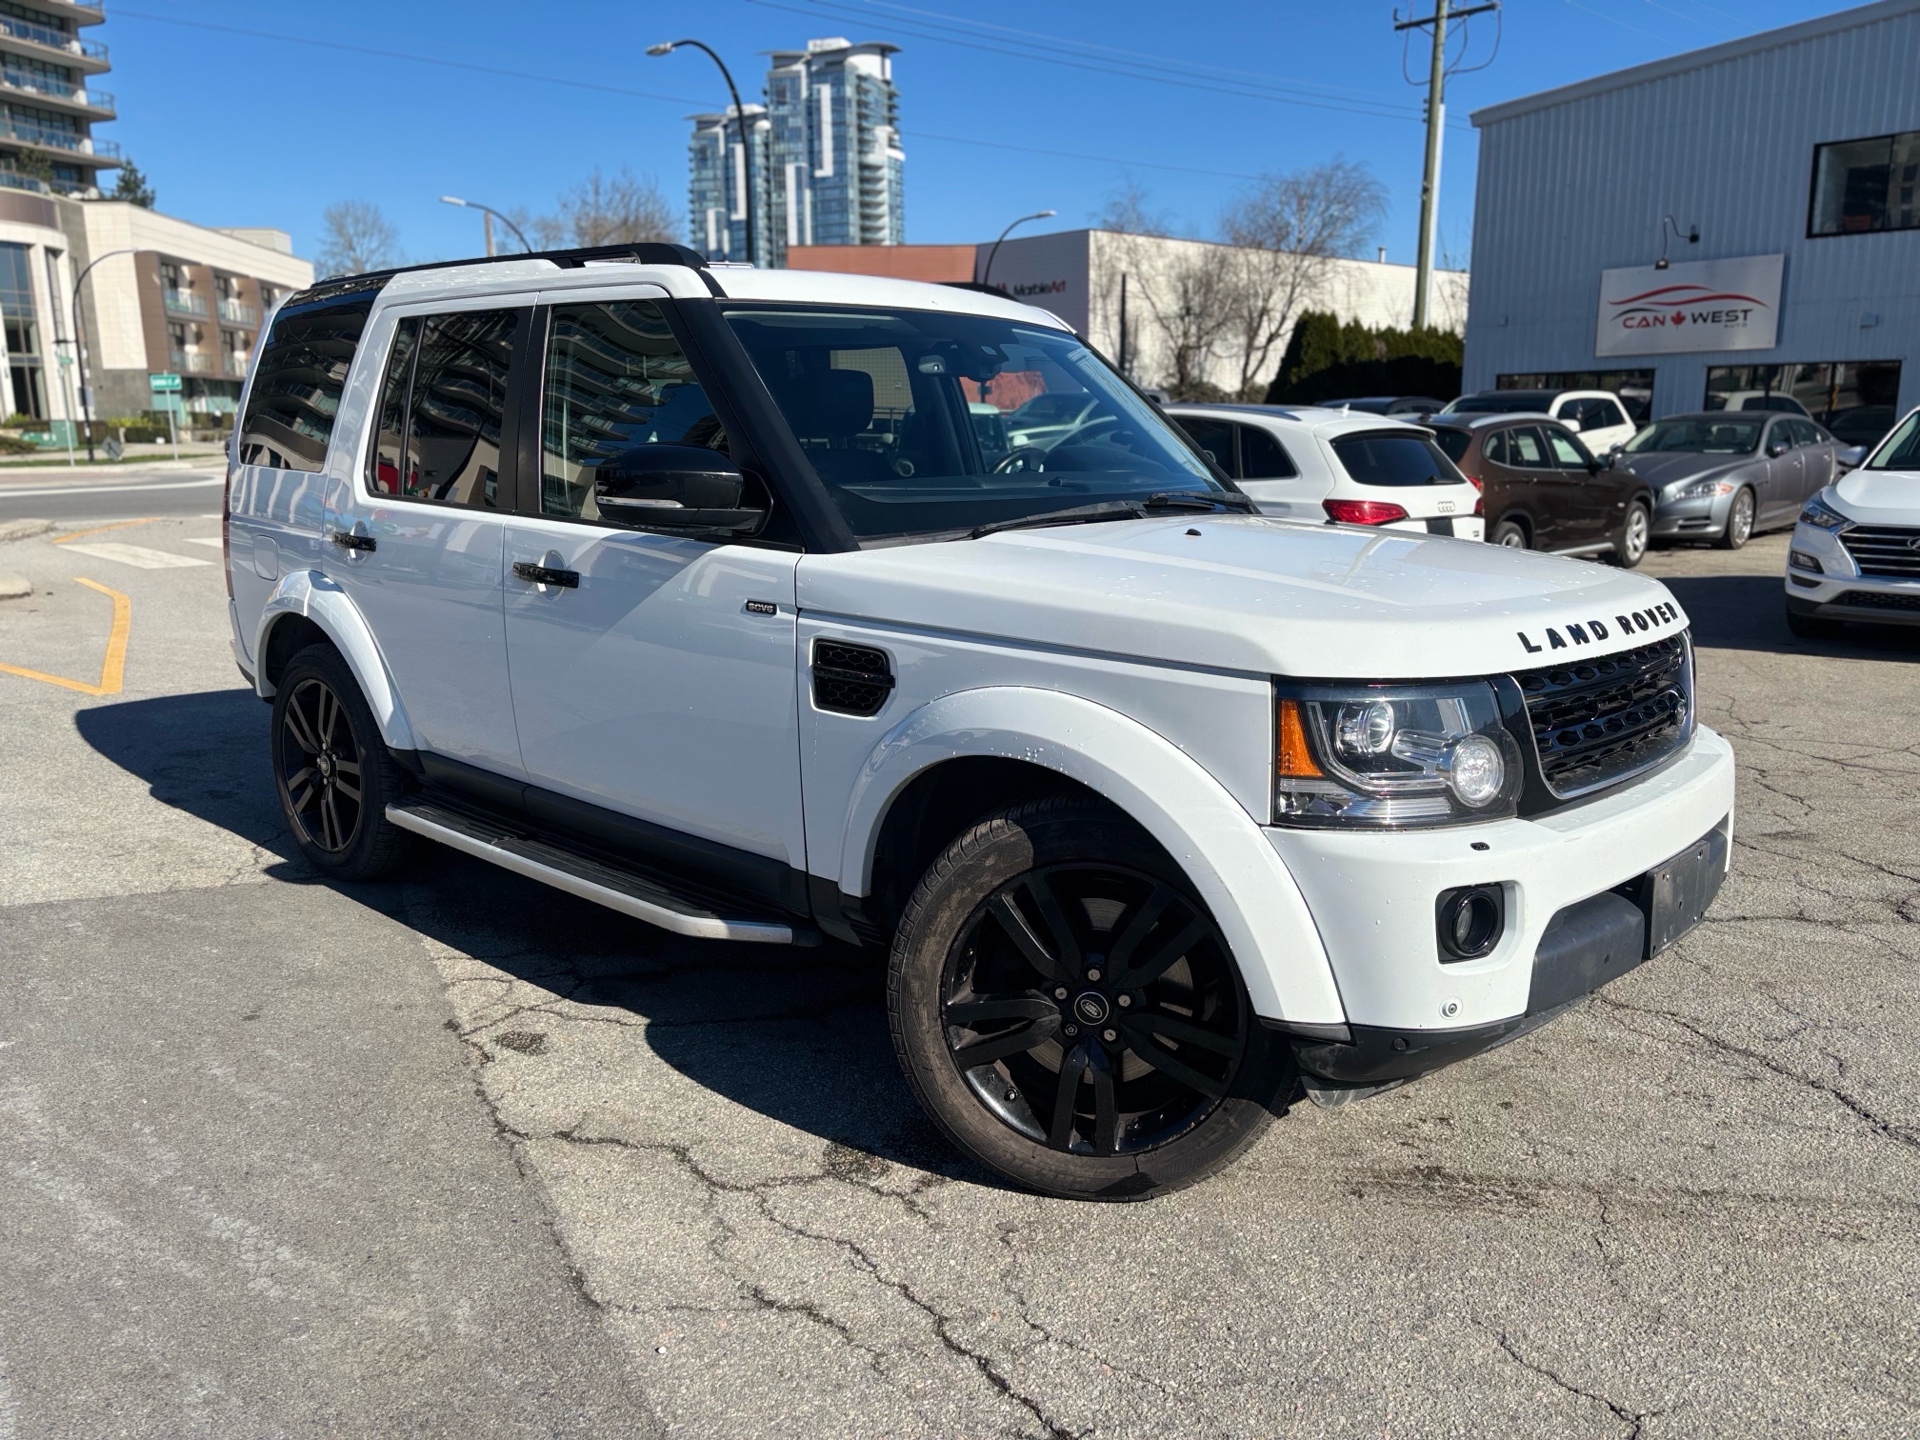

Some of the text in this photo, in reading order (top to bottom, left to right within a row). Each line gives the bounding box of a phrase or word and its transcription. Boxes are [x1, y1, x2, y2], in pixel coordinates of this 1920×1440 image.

[1622, 308, 1754, 329] CAN WEST
[1516, 602, 1679, 654] LAND ROVER
